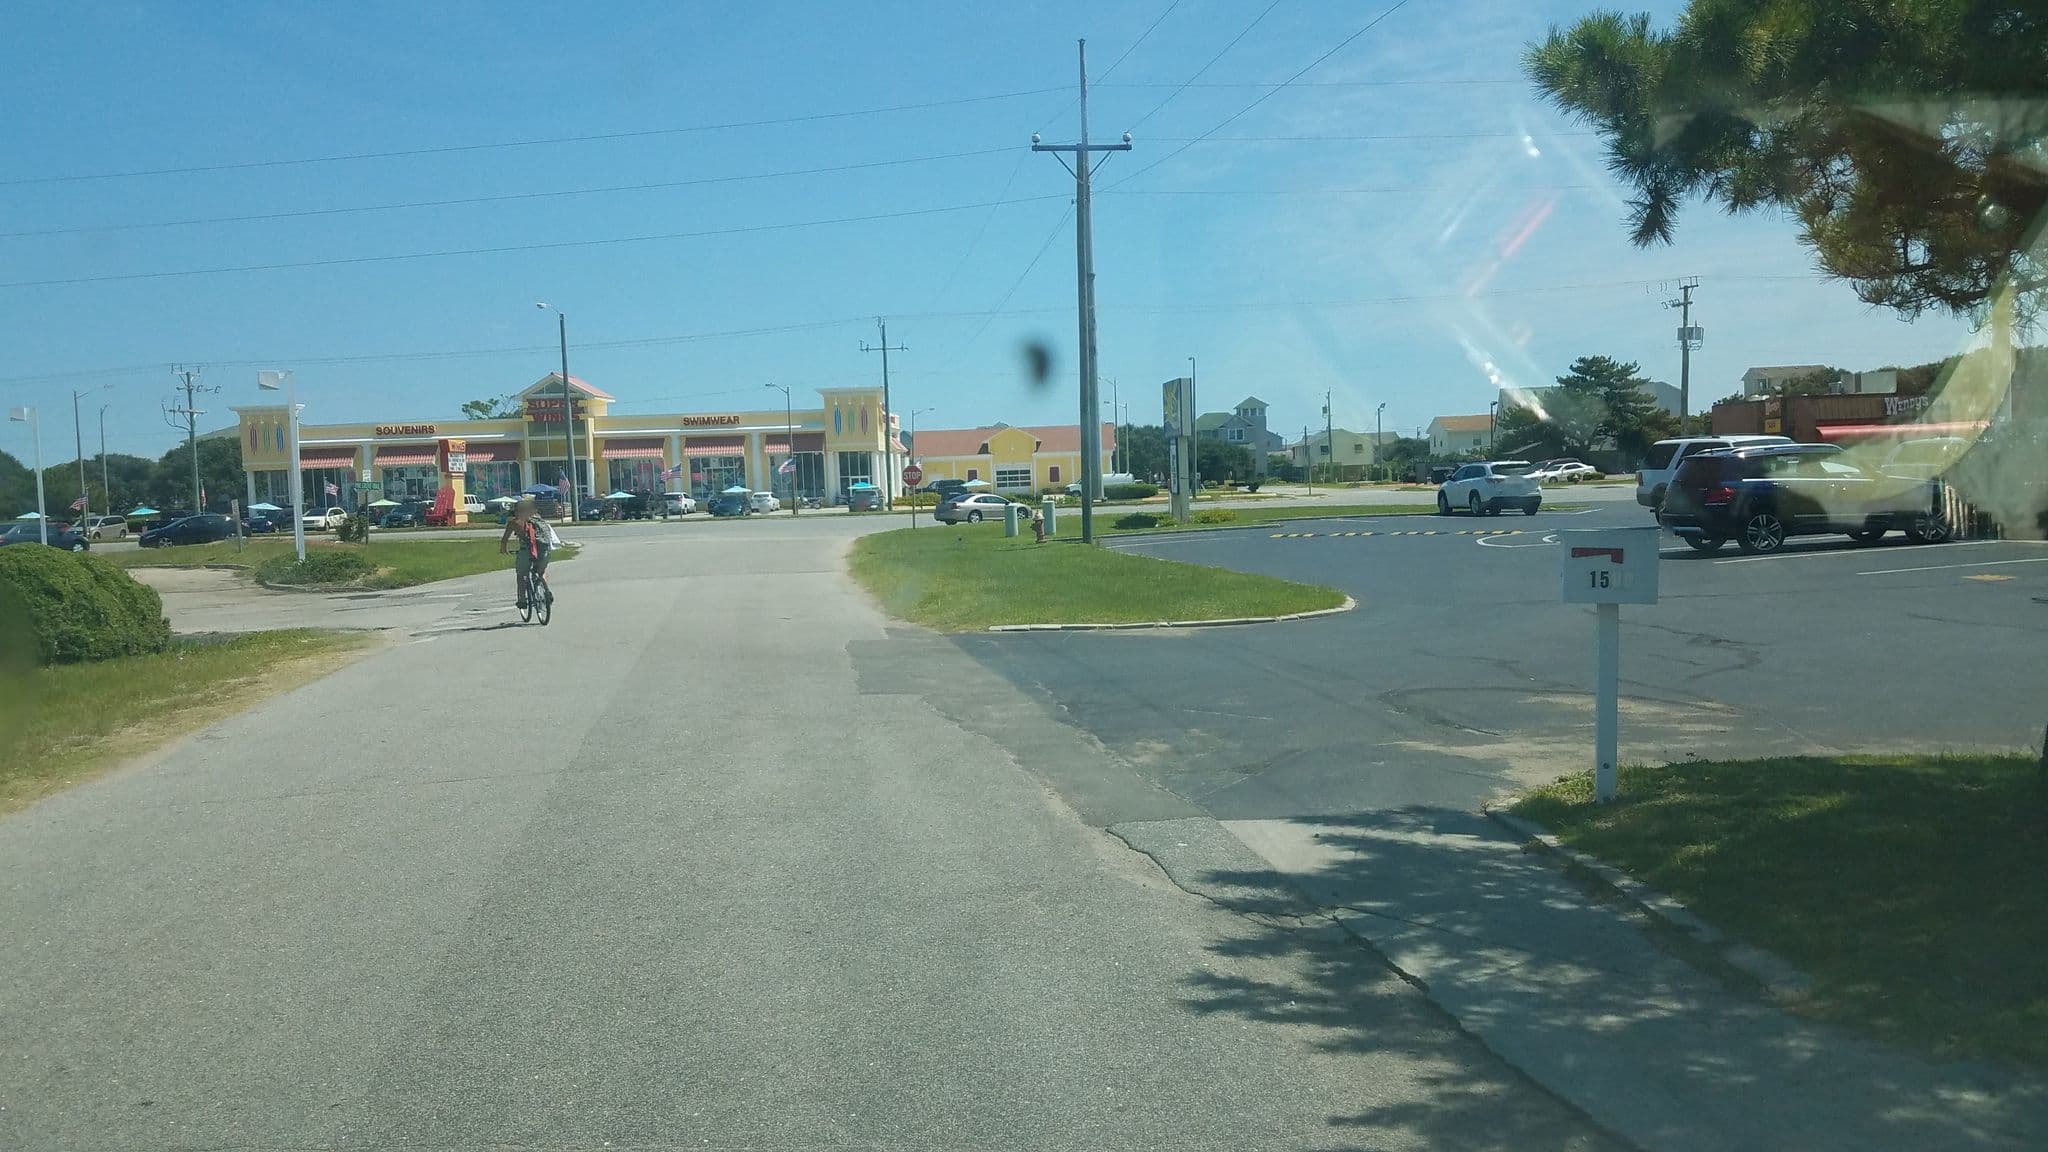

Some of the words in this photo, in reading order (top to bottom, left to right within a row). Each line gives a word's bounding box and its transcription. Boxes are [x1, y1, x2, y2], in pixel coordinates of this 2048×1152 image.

[683, 416, 740, 426] SWIMWEAR
[376, 424, 435, 435] SOUVENIRS
[903, 471, 921, 480] STOP
[1590, 571, 1609, 588] 15
